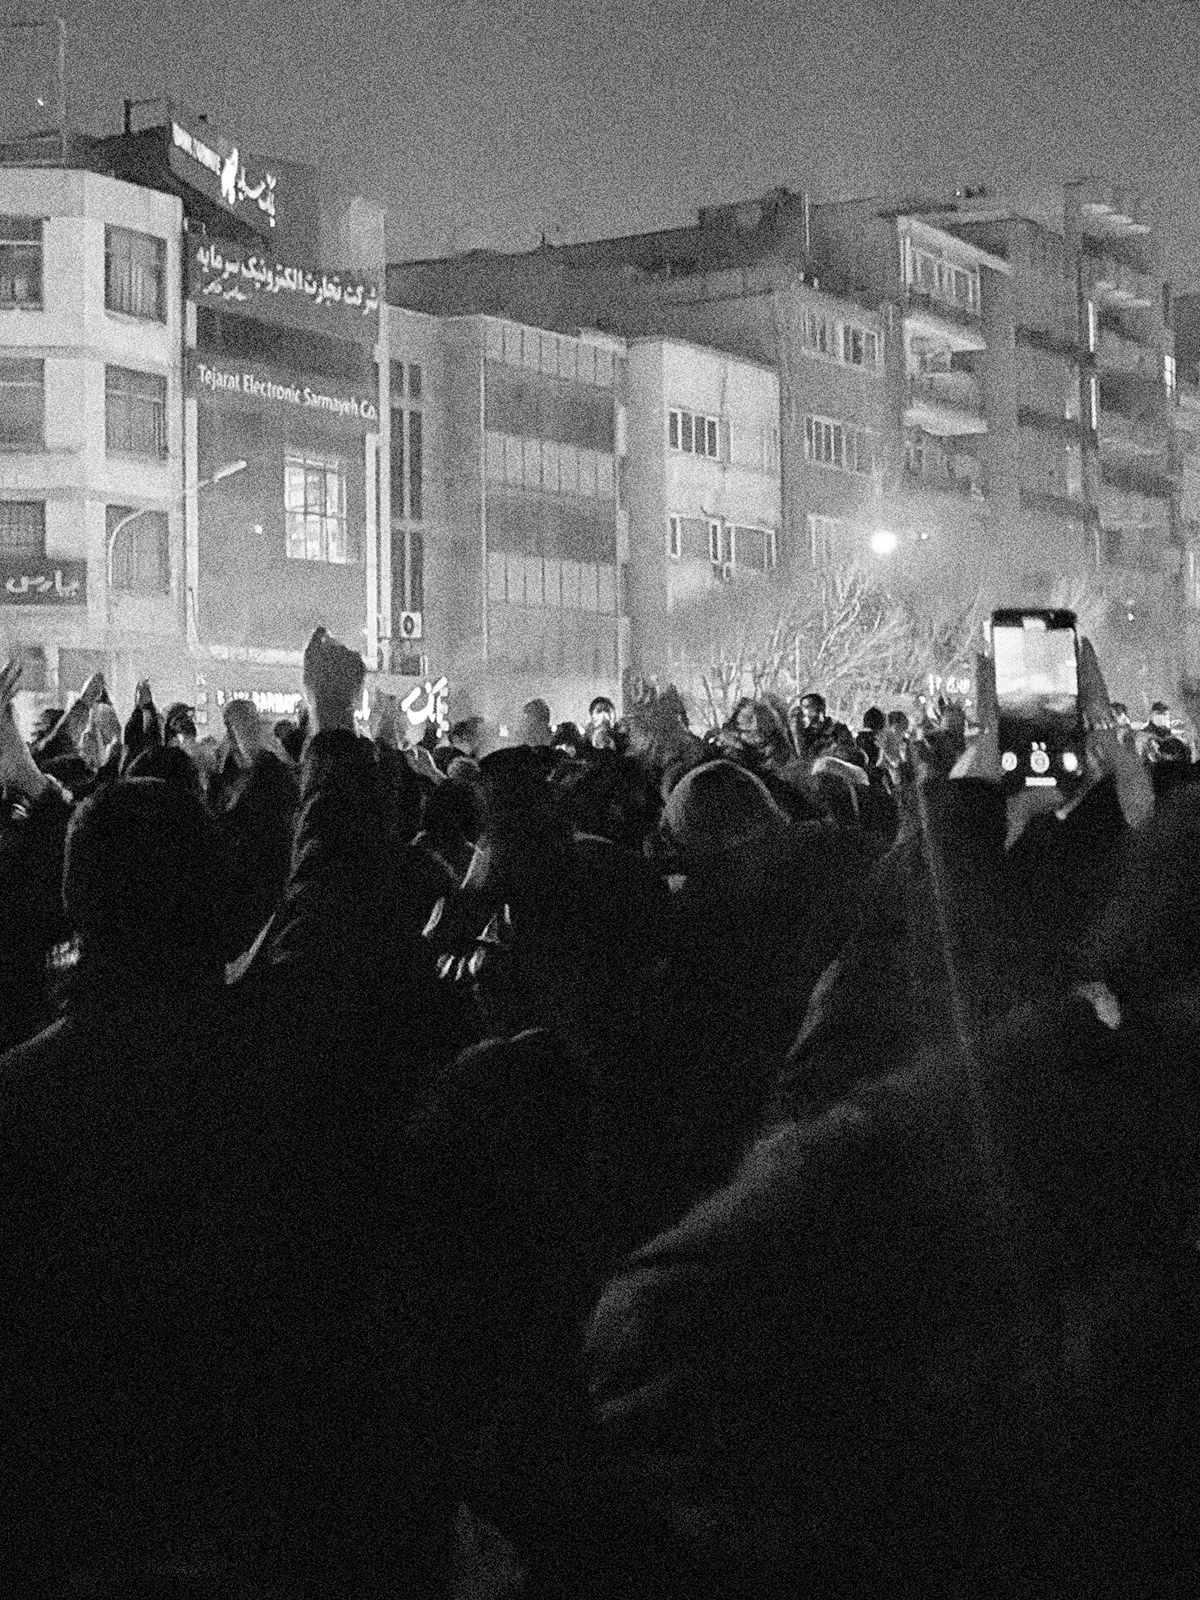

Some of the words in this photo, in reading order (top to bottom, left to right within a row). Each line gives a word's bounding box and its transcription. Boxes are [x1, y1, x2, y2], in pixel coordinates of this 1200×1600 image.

[303, 273, 342, 305] تجارت
[198, 363, 241, 391] Tejarat
[243, 373, 301, 403] Electronic
[303, 387, 358, 416] Sarmayeh
